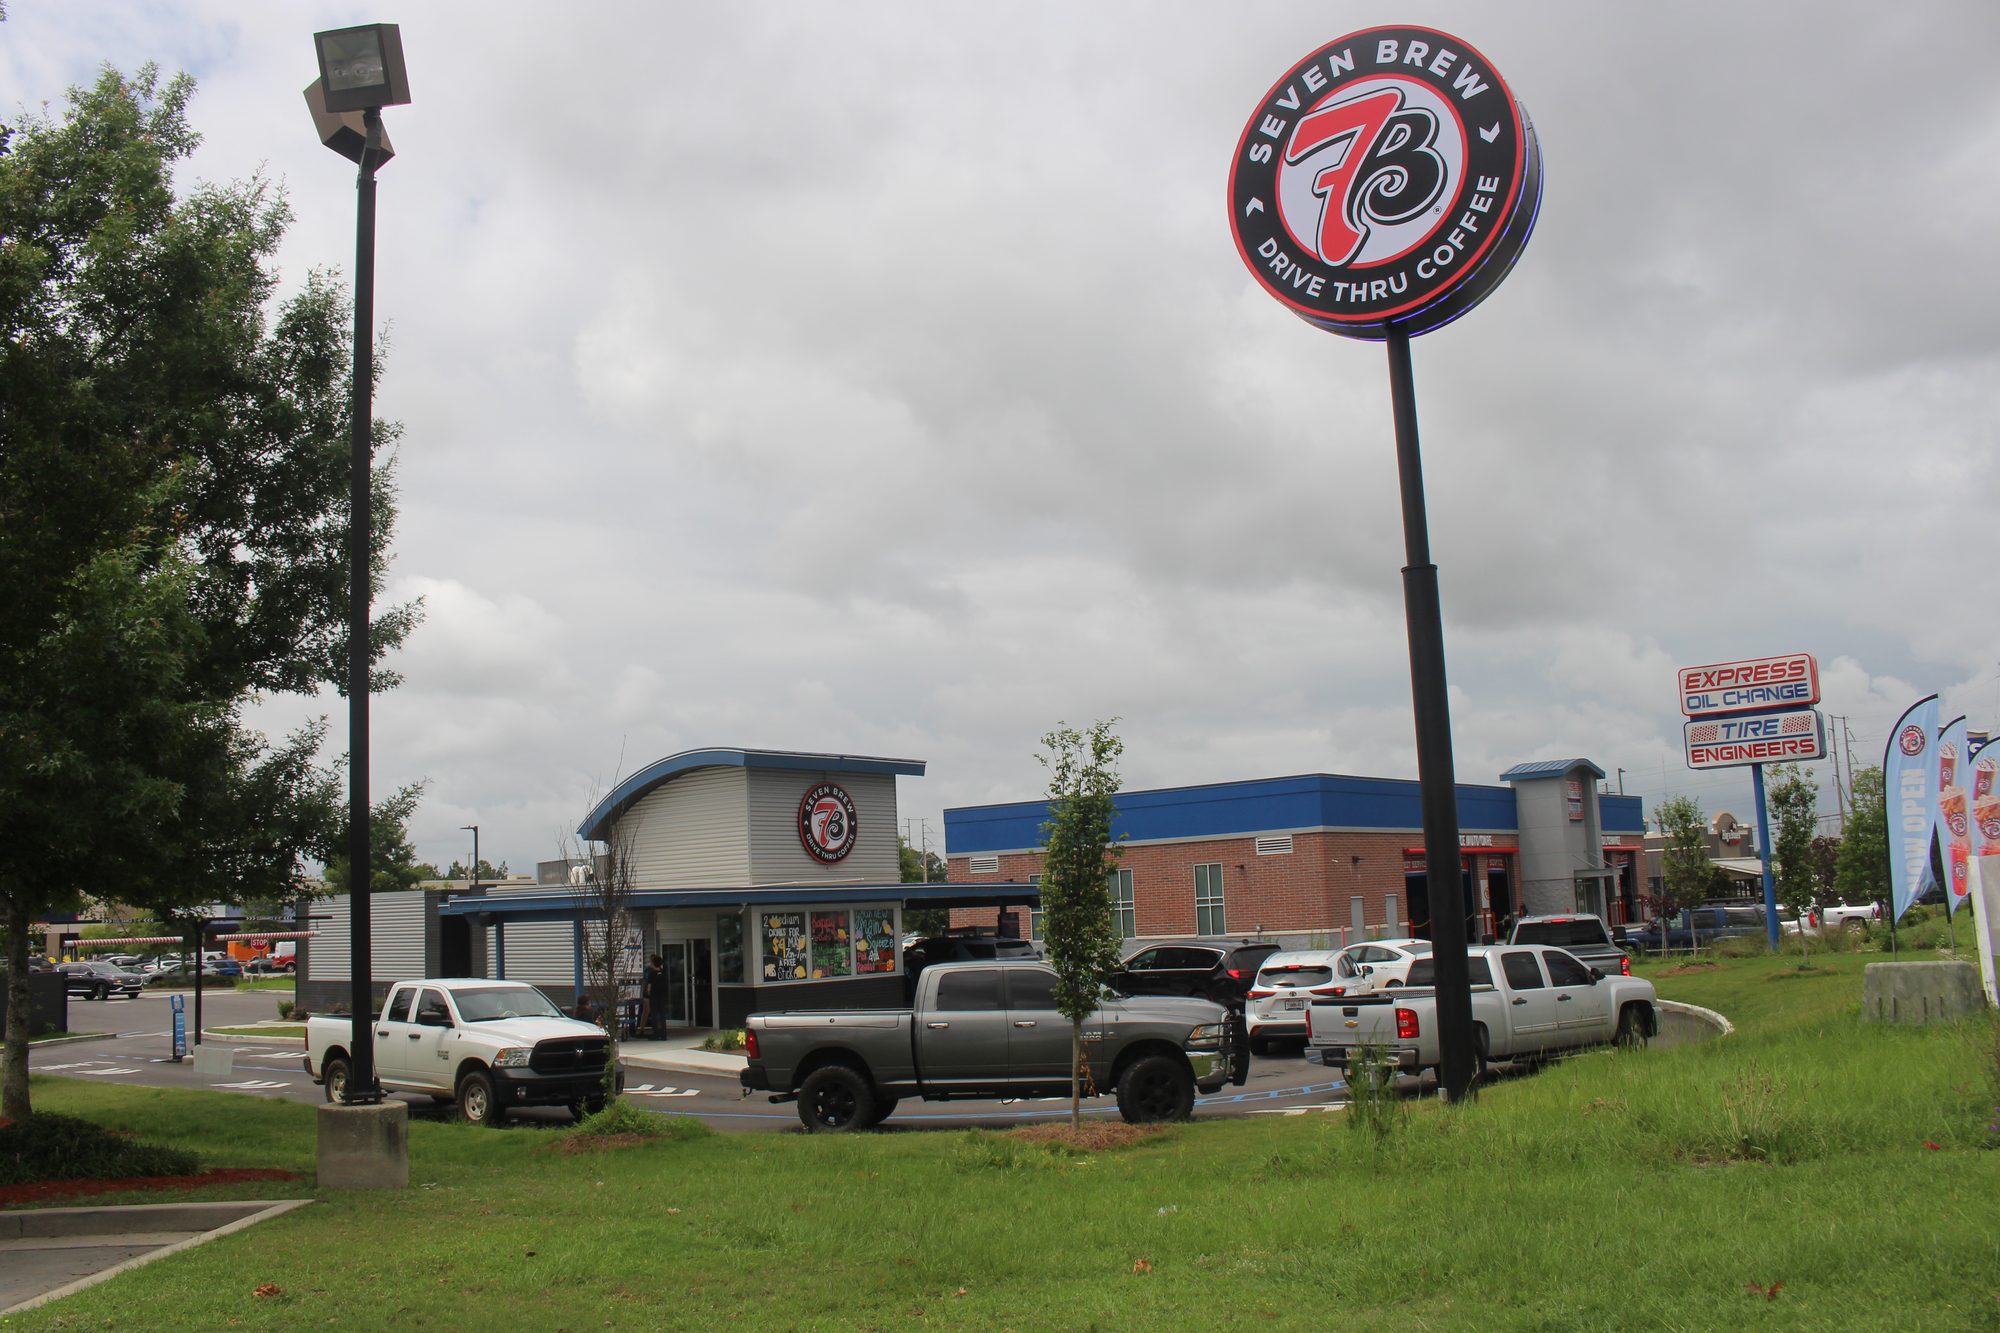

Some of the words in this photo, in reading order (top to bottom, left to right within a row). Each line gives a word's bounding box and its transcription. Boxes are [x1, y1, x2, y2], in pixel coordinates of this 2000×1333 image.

[1249, 48, 1355, 165] SEVEN
[1375, 39, 1490, 100] BREW
[1257, 237, 1327, 299] DRIVE
[1333, 272, 1408, 303] THRU
[1416, 175, 1500, 280] COFFEE
[1685, 659, 1806, 690] EXPRESS
[1686, 694, 1718, 710] OIL
[1722, 682, 1809, 706] CHANGE
[1721, 718, 1780, 739] TIRE
[1691, 738, 1816, 764] ENGINEERS
[805, 786, 829, 812] SEVEN
[833, 787, 854, 813] BREW
[1901, 768, 1927, 832] OPEN
[806, 833, 821, 855] DRIVE
[821, 851, 837, 860] THRU
[837, 833, 855, 858] COFFEE
[763, 915, 769, 927] 2
[788, 927, 800, 937] FOR
[783, 958, 797, 967] FREE
